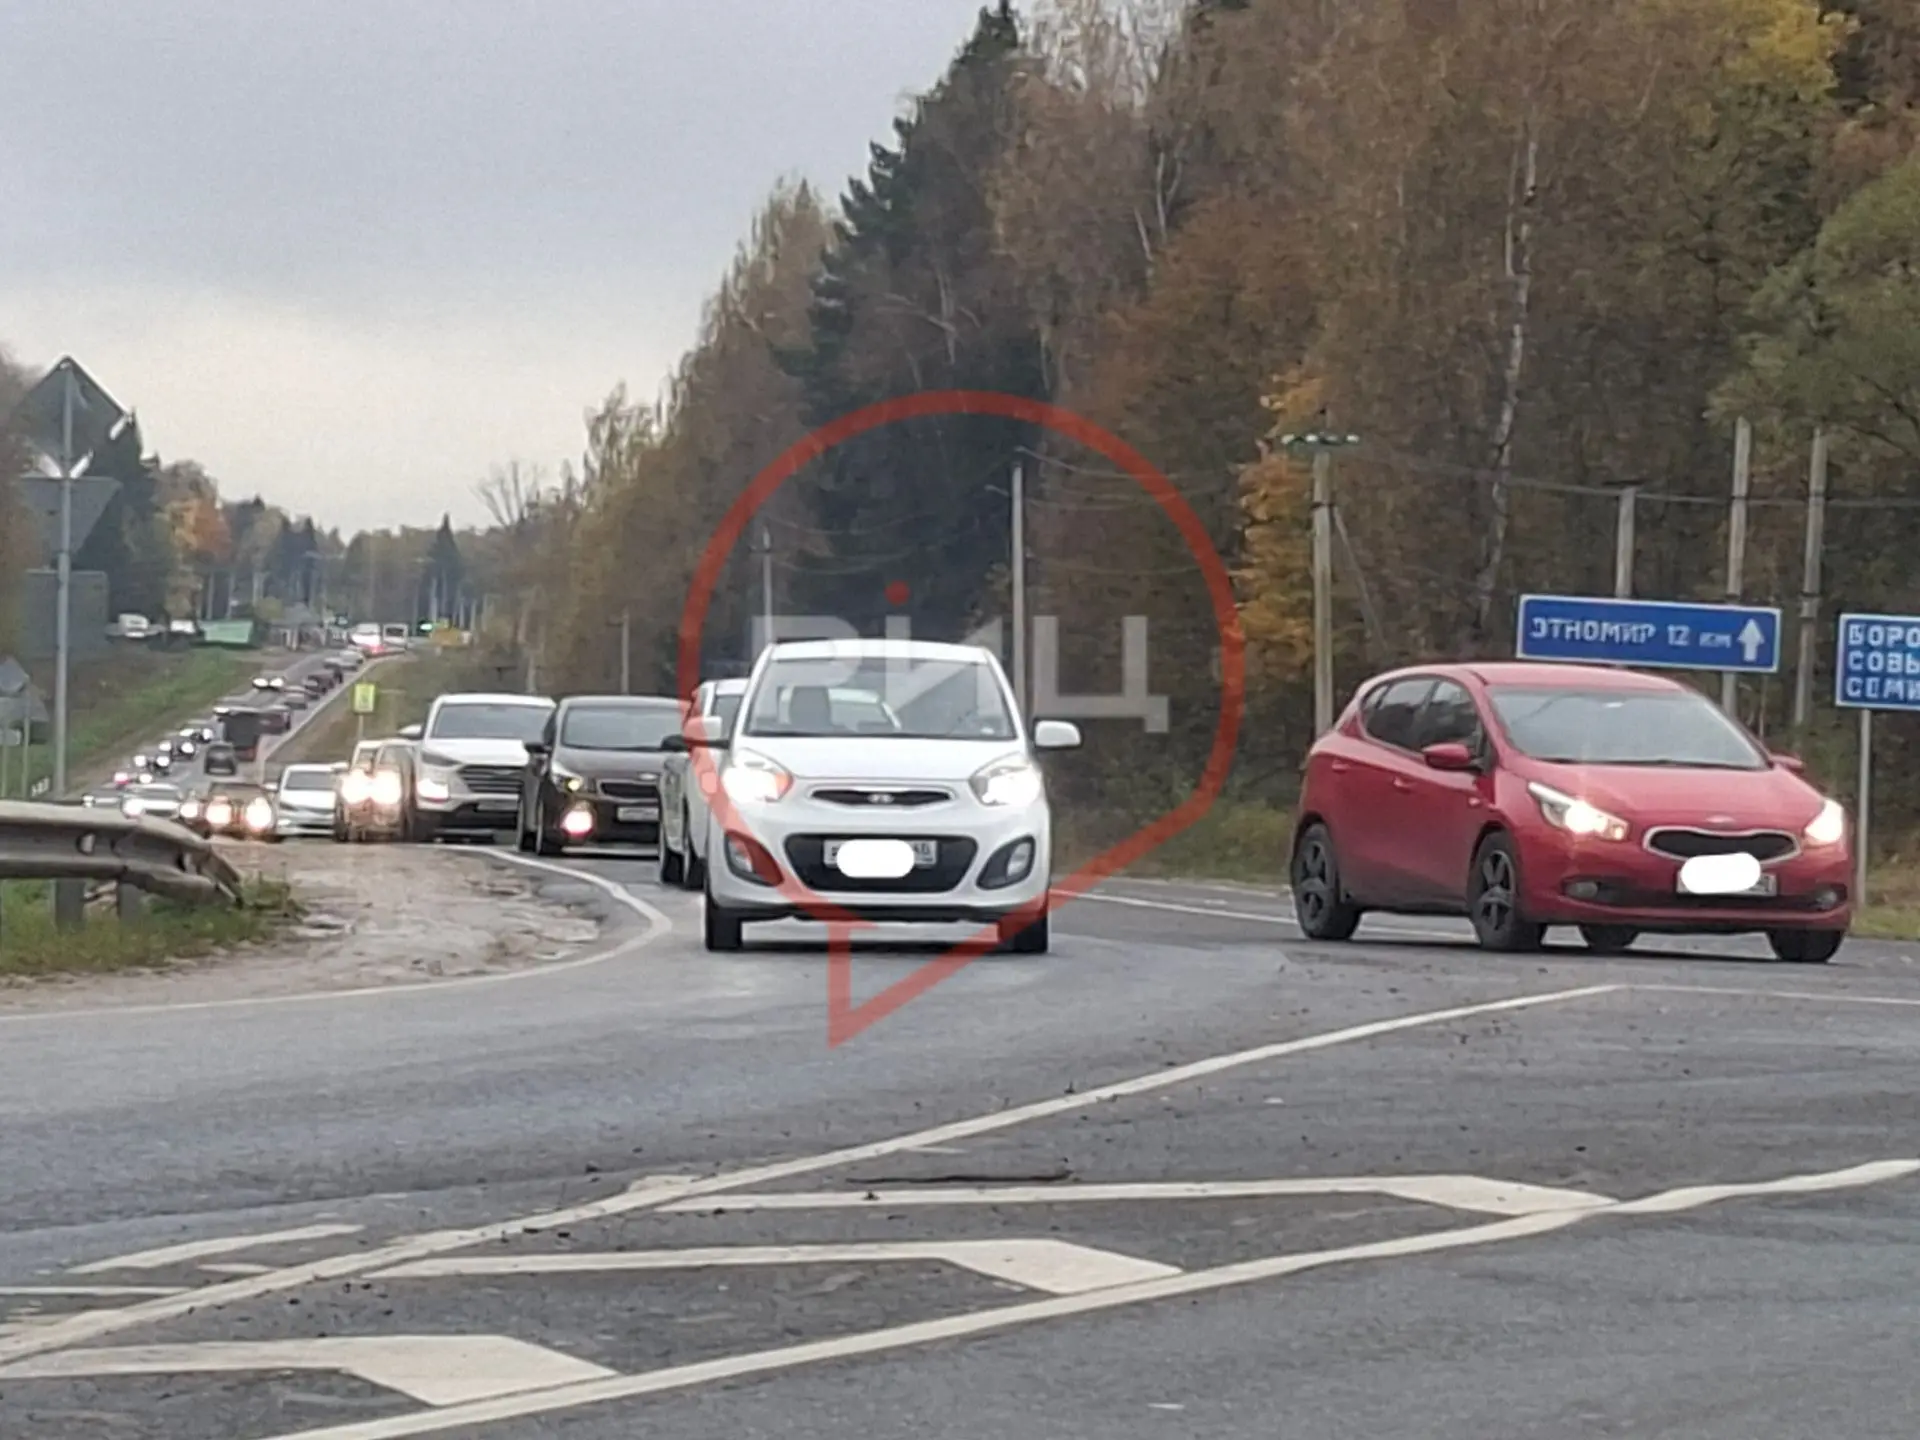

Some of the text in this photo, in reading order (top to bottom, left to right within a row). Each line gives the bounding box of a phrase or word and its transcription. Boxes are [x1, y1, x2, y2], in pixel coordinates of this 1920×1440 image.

[1530, 617, 1732, 649] ЭТНОМИР 12 км
[1848, 623, 1920, 648] БОРО
